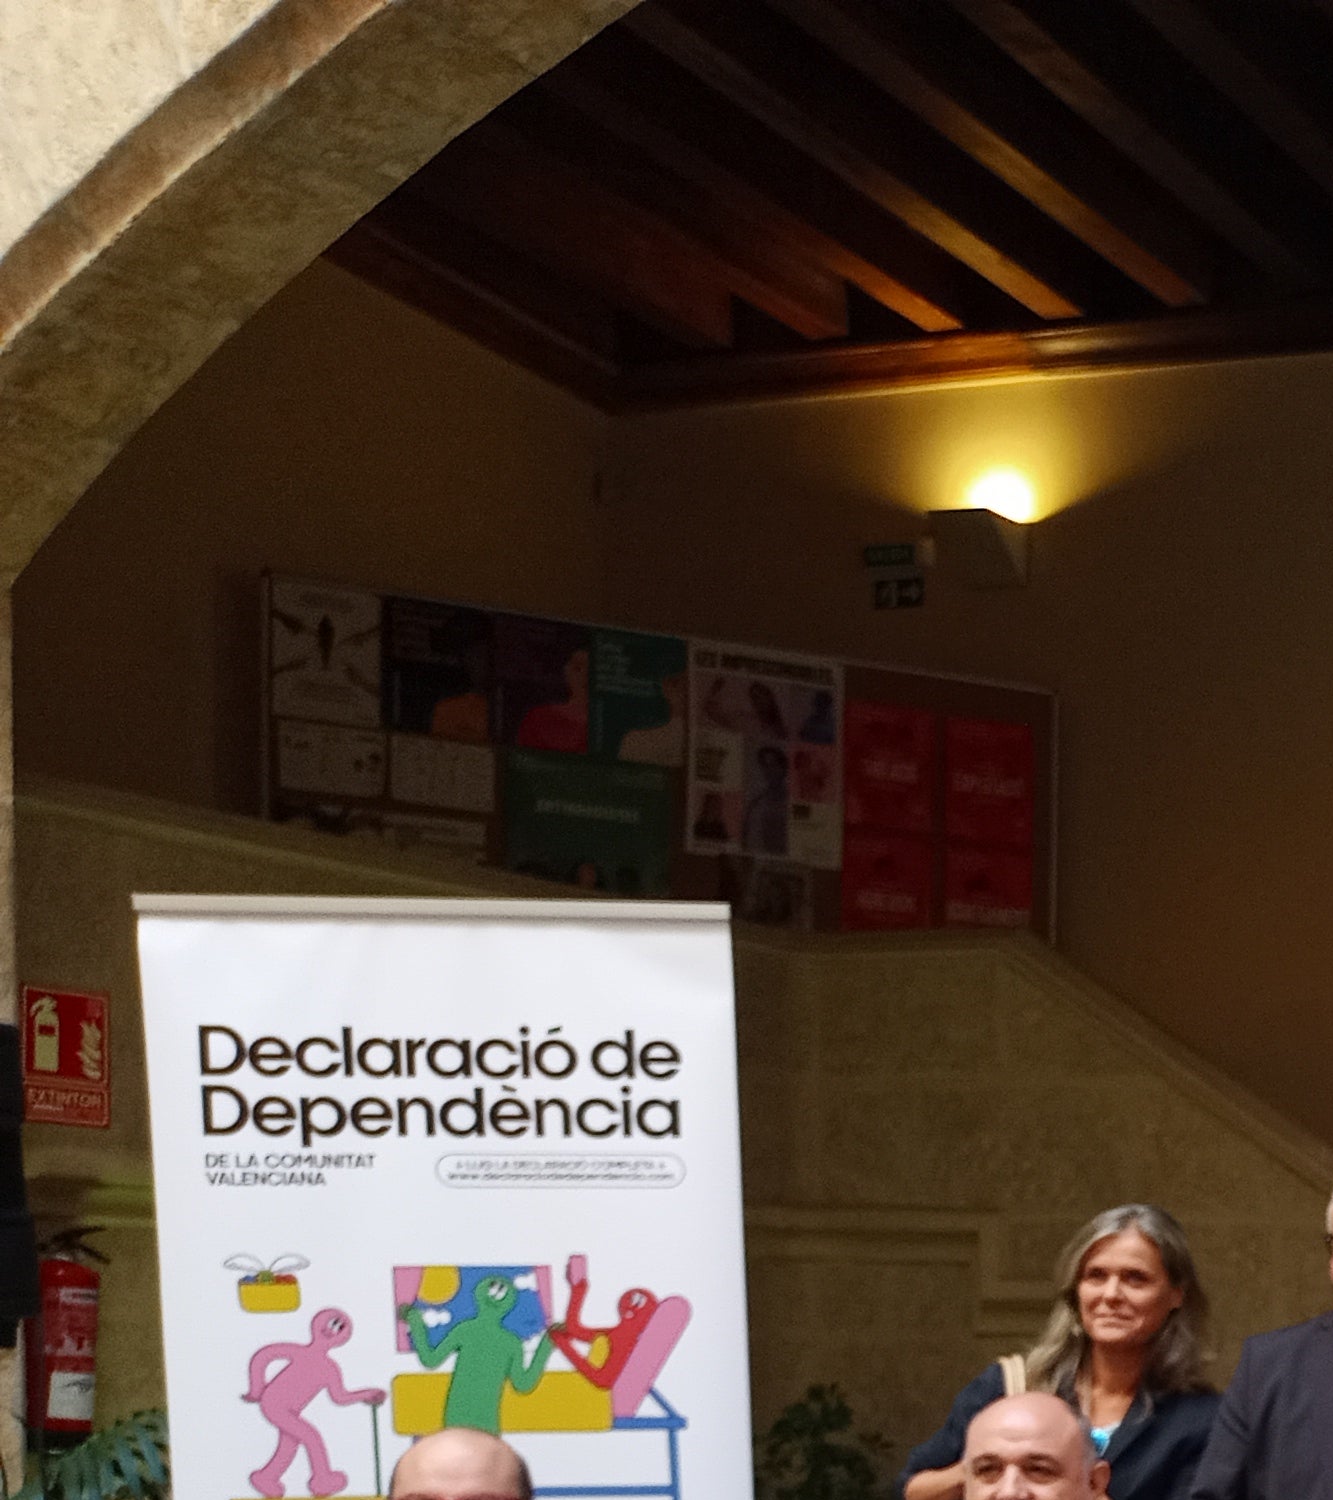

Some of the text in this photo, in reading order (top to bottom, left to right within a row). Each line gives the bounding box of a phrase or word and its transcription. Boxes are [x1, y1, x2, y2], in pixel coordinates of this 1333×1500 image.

[199, 1025, 681, 1080] Declaració de
[201, 1084, 681, 1147] Dependència
[204, 1153, 375, 1169] DE LA COMUNITAT
[206, 1171, 326, 1186] VALENCIANA
